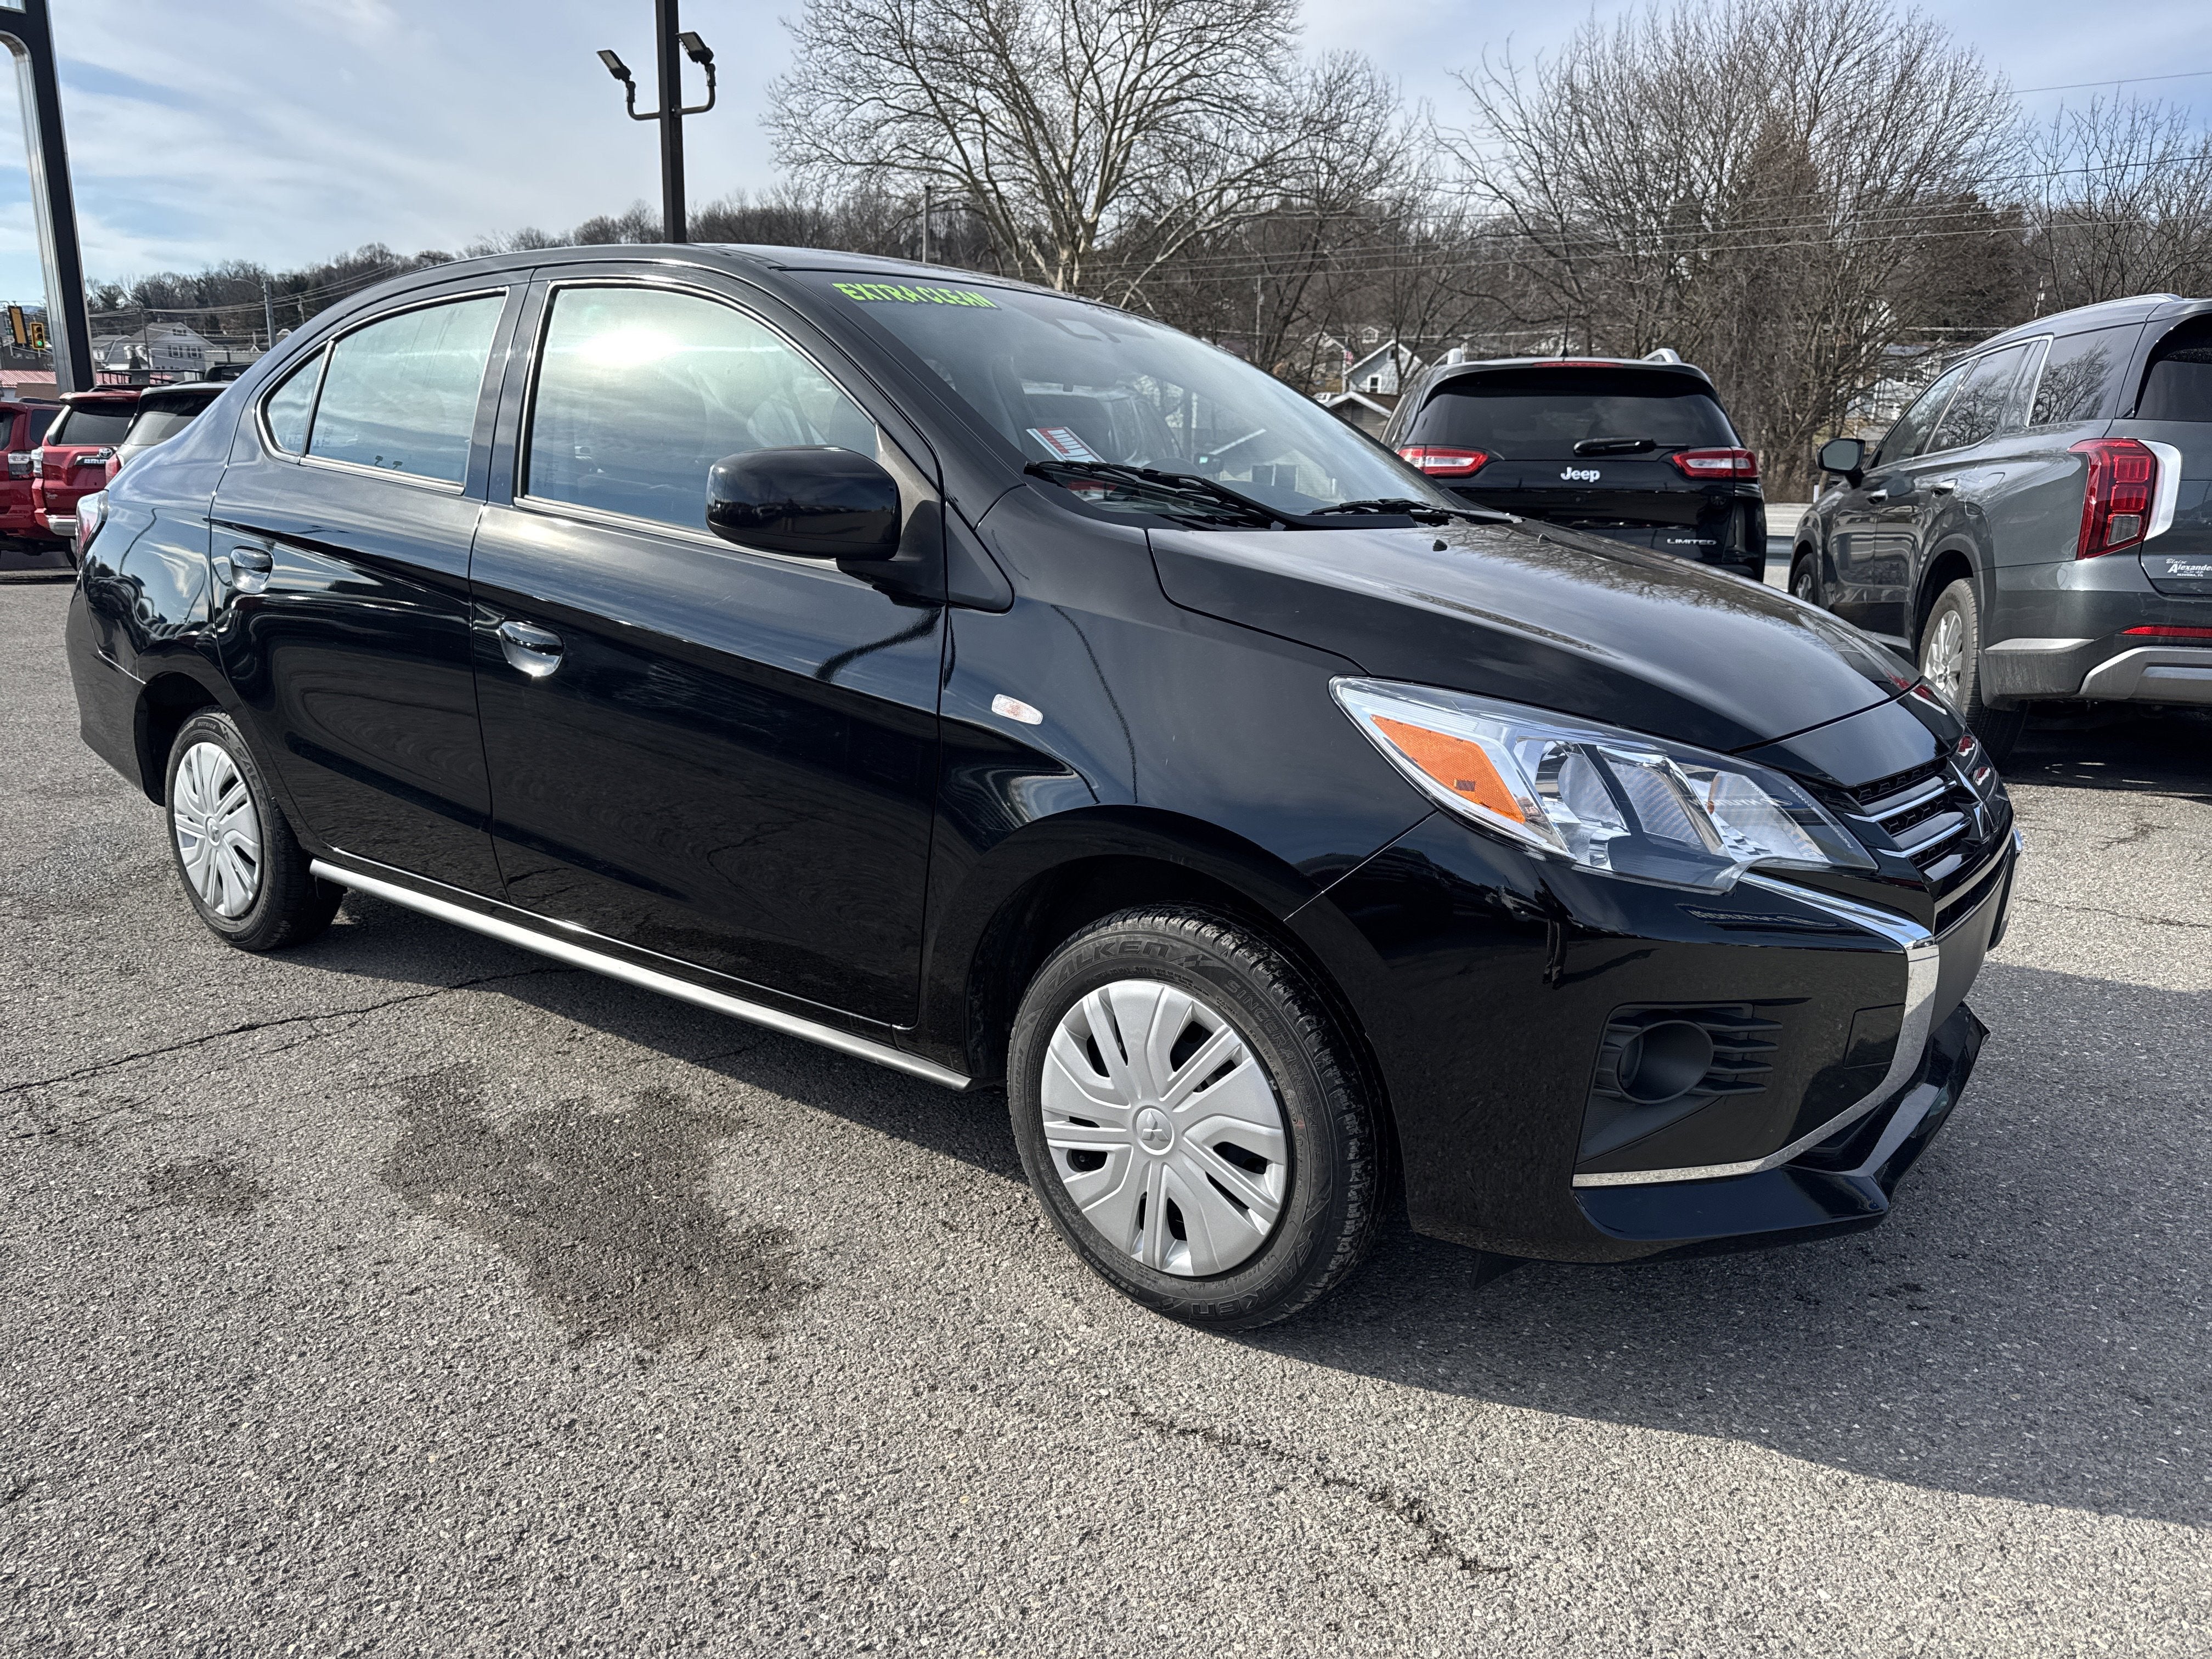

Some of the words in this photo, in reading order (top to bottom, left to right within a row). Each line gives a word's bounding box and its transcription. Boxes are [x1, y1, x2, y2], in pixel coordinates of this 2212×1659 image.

[832, 283, 928, 303] EXTRA
[916, 286, 998, 308] CLEAN
[1560, 466, 1600, 483] Jeep
[198, 721, 217, 730] OUTSIDE
[1039, 940, 1169, 1002] FALKEN
[1224, 978, 1297, 1063] SINCERA
[1191, 1231, 1314, 1316] FALKEN
